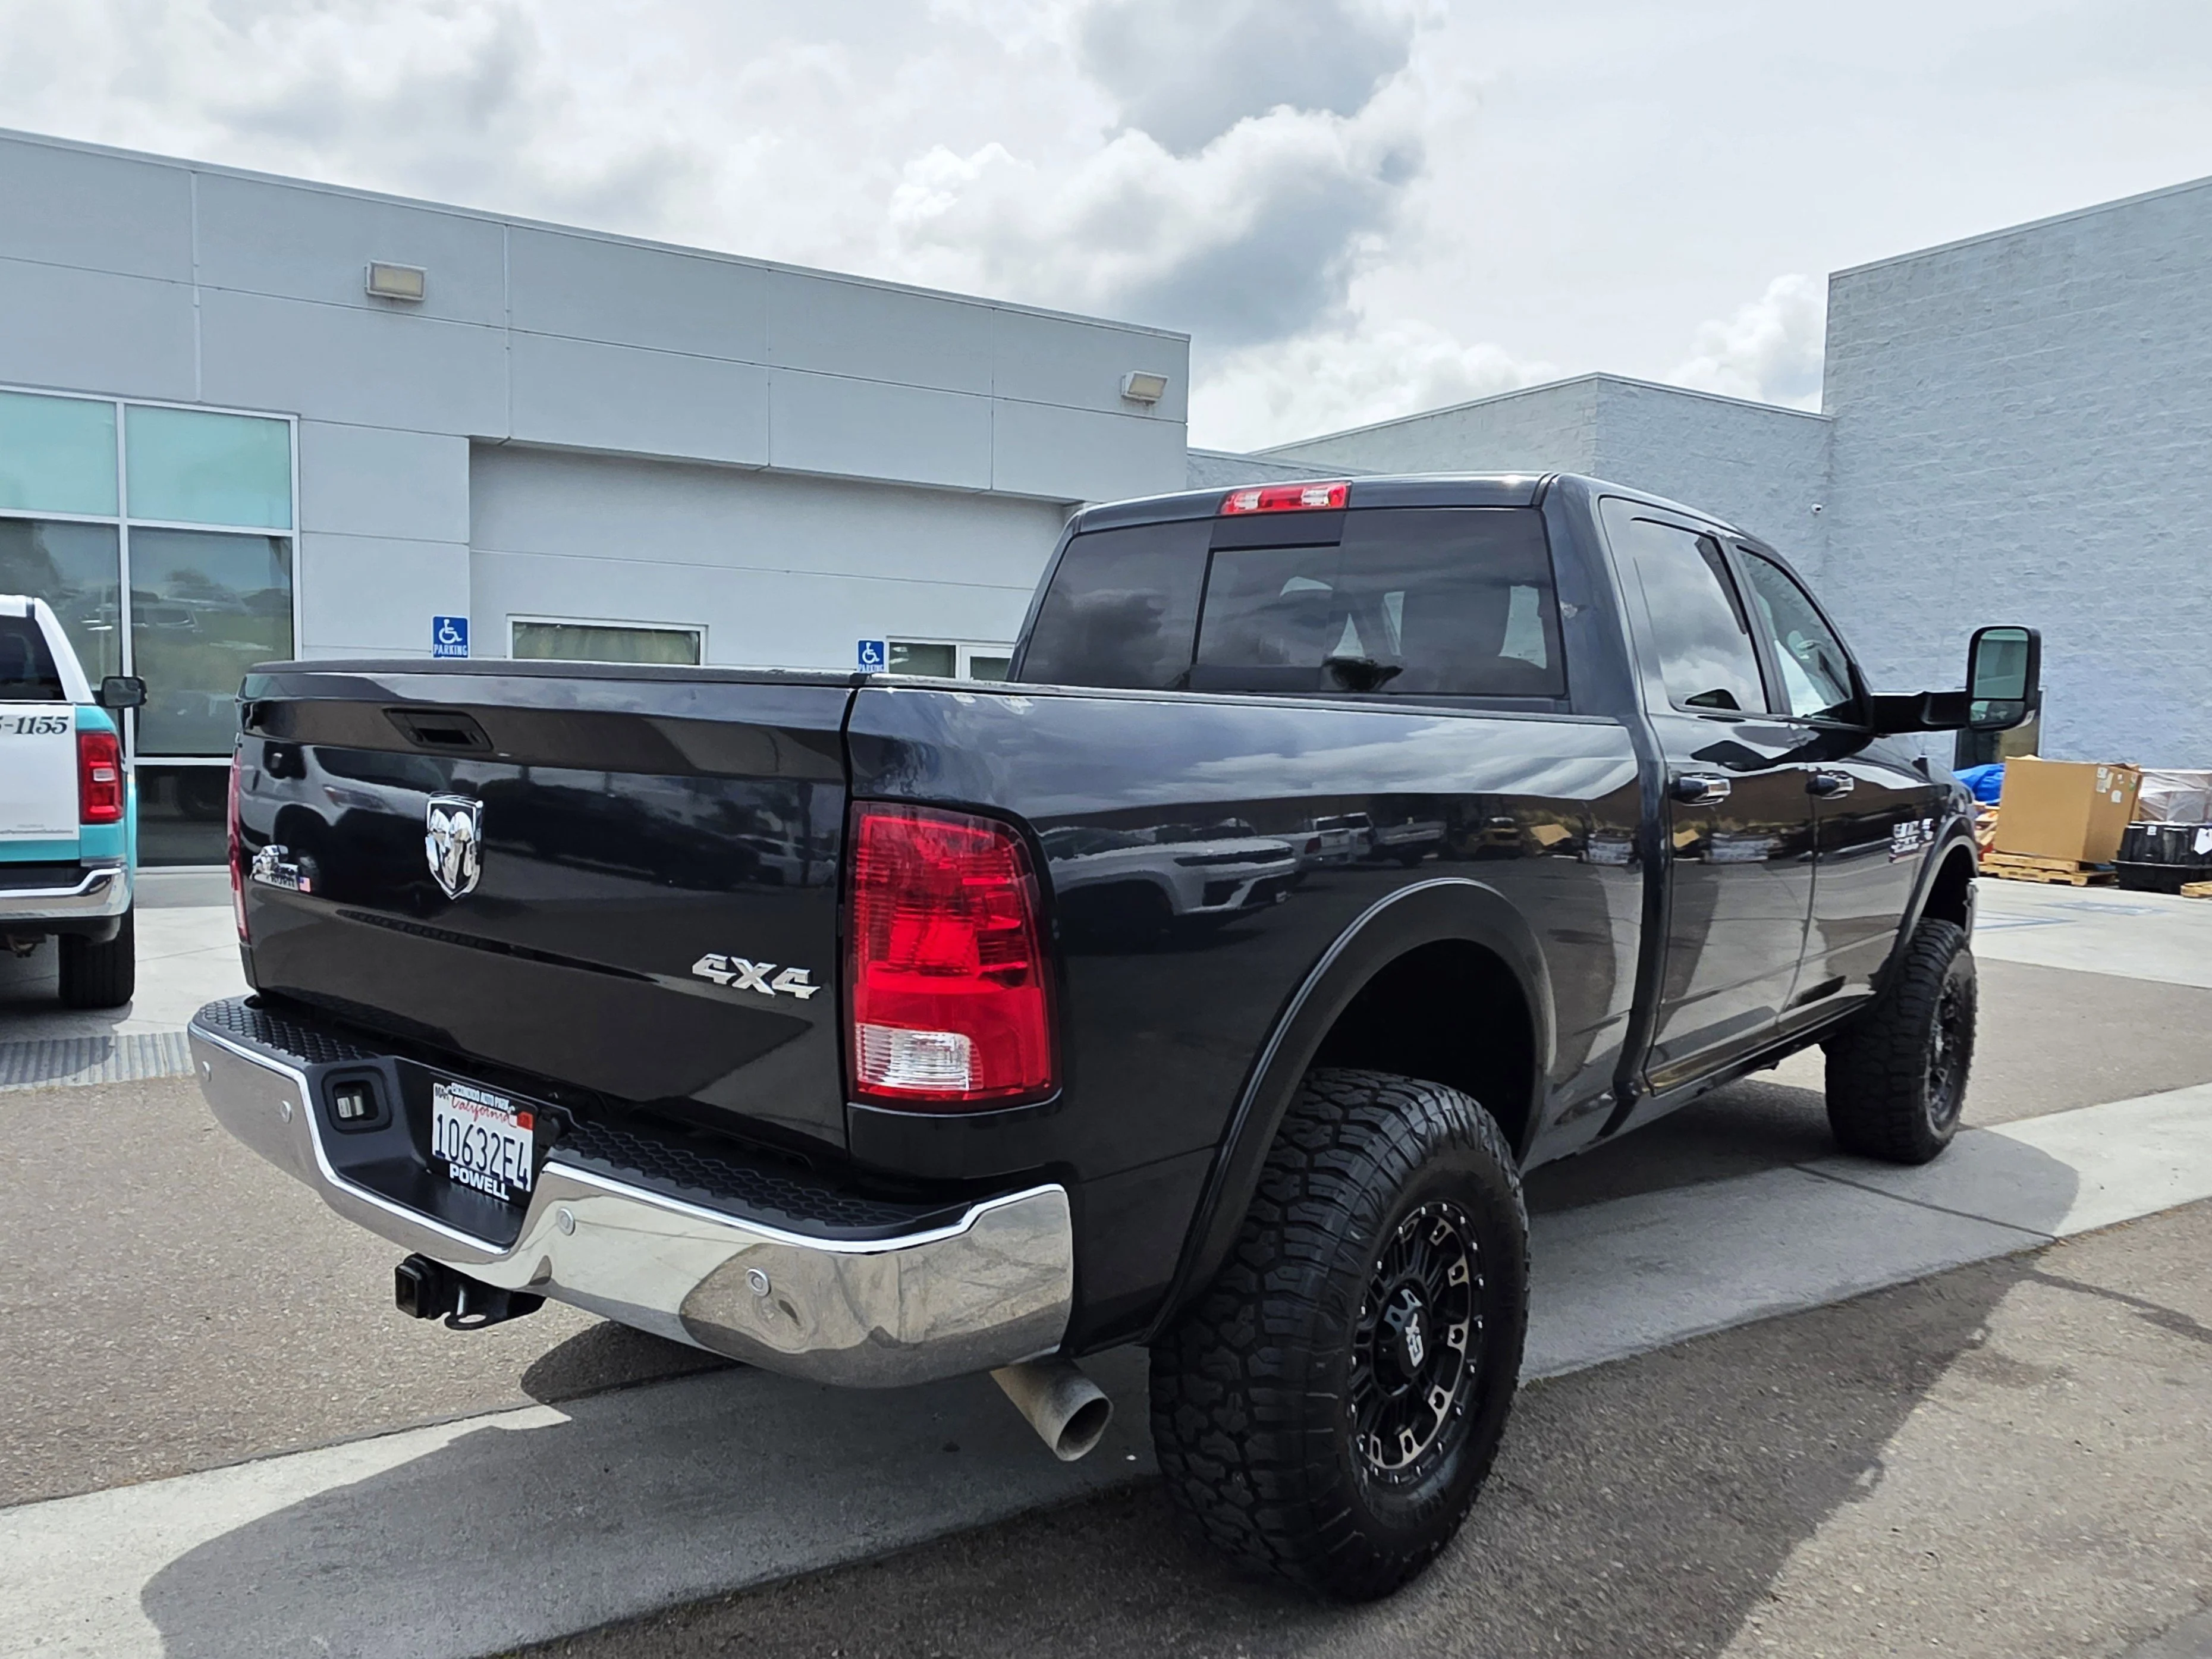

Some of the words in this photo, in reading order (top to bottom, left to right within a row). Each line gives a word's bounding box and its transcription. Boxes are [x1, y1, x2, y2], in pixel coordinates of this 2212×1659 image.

[433, 644, 467, 656] PARKING
[435, 1114, 528, 1189] 10632E4
[450, 1163, 510, 1201] POWELL
